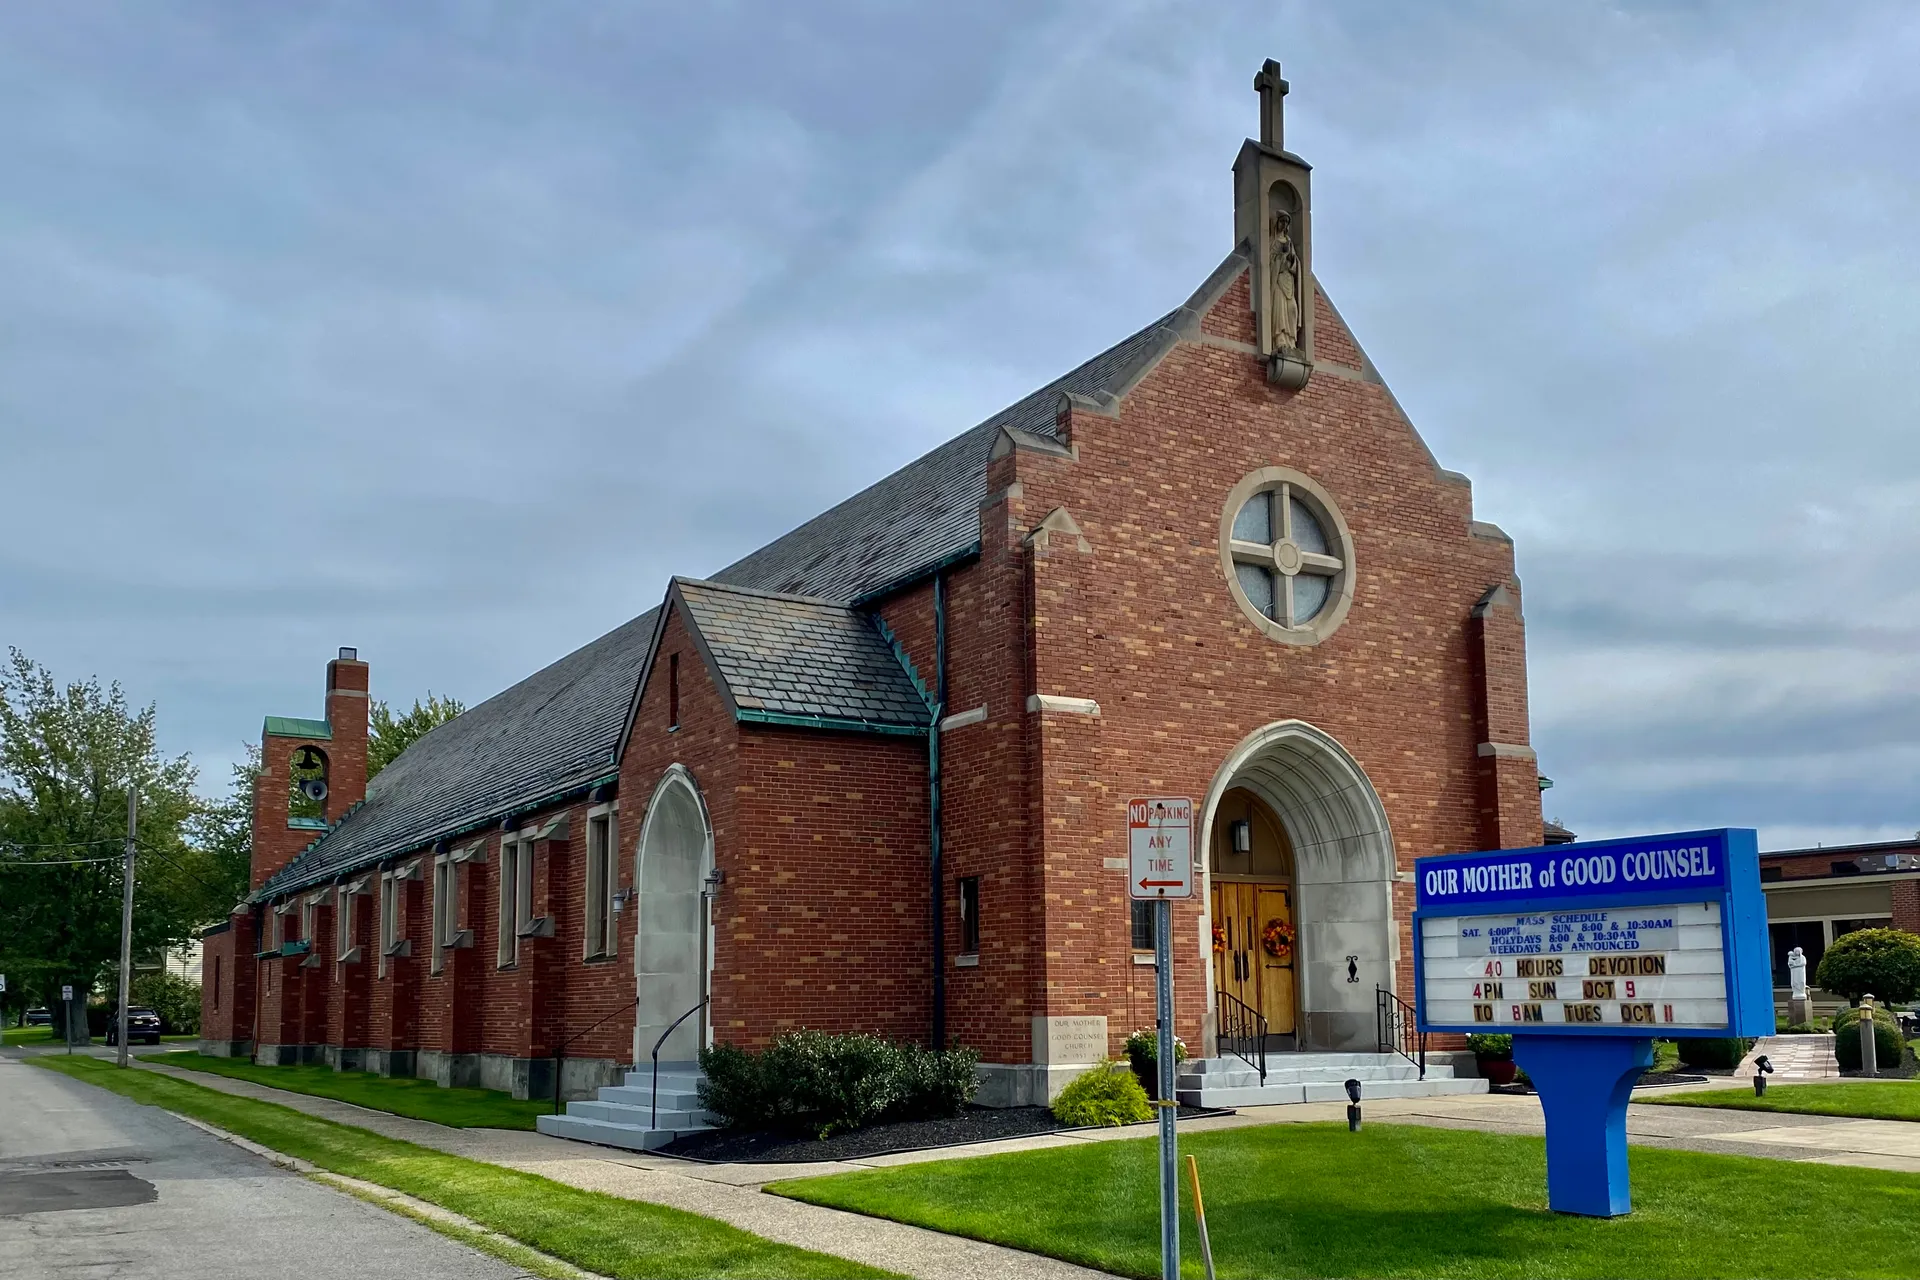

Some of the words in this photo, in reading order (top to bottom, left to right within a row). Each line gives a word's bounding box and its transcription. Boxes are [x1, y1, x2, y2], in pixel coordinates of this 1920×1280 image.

[1130, 804, 1147, 823] NO
[1149, 806, 1189, 819] PARKING
[1149, 836, 1172, 848] ANY
[1148, 859, 1174, 871] TIME
[1425, 869, 1458, 896] OUR
[1462, 862, 1533, 893] MOTHER
[1539, 860, 1556, 888] of
[1561, 856, 1616, 886] GOOD
[1622, 846, 1715, 881] COUNSEL
[1516, 916, 1545, 926] MASS
[1552, 913, 1608, 924] SCHEDULE
[1462, 928, 1481, 938] SAT.
[1488, 927, 1520, 937] 4:00PM
[1550, 924, 1574, 934] SUN.
[1581, 923, 1603, 932] 8:00
[1611, 922, 1619, 931] &
[1627, 919, 1673, 930] 10:30AM
[1491, 935, 1542, 945] HOLYDAYS
[1549, 934, 1569, 943] 8:00
[1577, 933, 1585, 942] &
[1593, 931, 1636, 941] 10:30AM
[1489, 944, 1541, 954] WEEKDAYS
[1549, 943, 1563, 952] AS
[1571, 941, 1640, 951] ANNOUNCED
[1485, 961, 1502, 977] 40
[1517, 959, 1563, 977] HOURS
[1589, 956, 1665, 975] DEVOTION
[1529, 981, 1557, 999] SUN
[1584, 981, 1614, 999] OCT
[1625, 981, 1636, 998] 9
[1474, 1004, 1493, 1021] TO
[1564, 1005, 1602, 1022] TUES
[1620, 1004, 1654, 1022] OCT
[1664, 1004, 1673, 1022] 11
[1072, 1019, 1101, 1027] MOTHER
